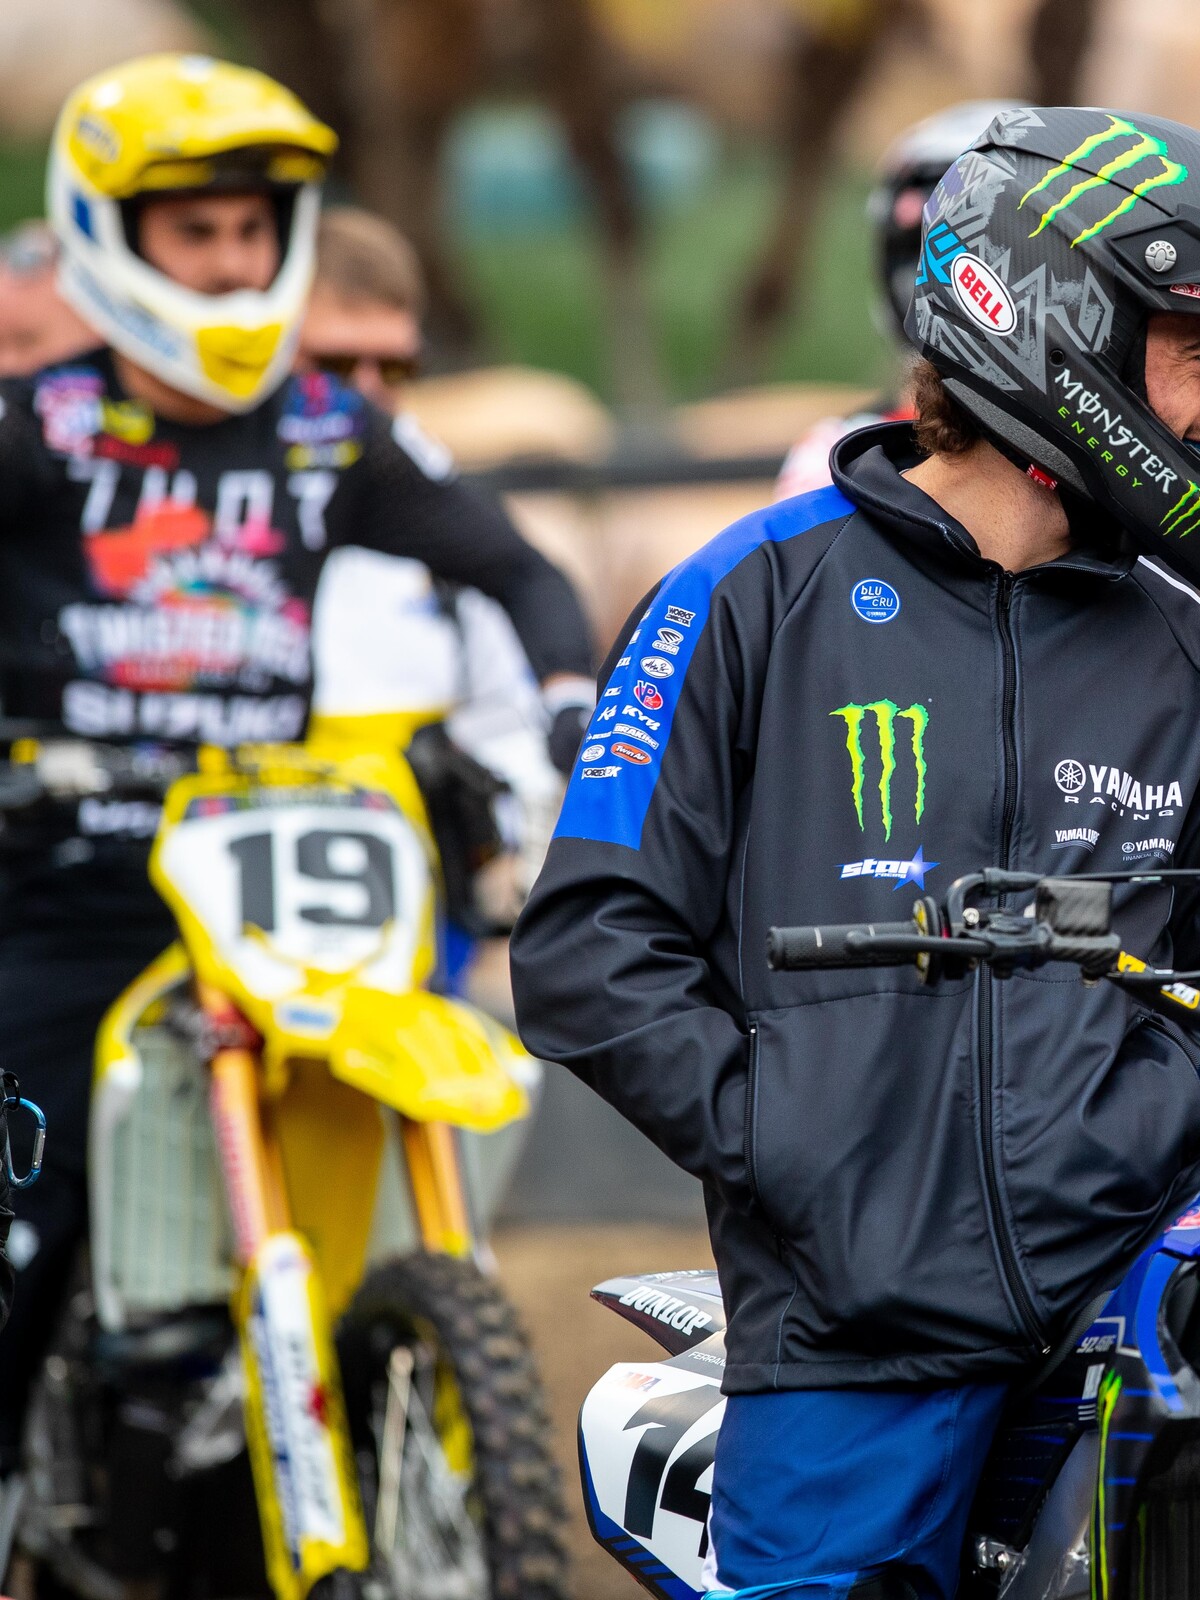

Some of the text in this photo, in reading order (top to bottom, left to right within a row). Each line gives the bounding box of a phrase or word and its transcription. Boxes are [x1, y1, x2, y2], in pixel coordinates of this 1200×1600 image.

[958, 263, 1004, 326] BELL
[1057, 405, 1143, 488] ENERGY
[613, 724, 658, 749] BRAKING
[615, 745, 635, 757] Twin
[633, 752, 646, 760] Air
[1064, 795, 1174, 820] RACING
[1088, 764, 1183, 811] YAMAHA
[228, 828, 395, 932] 19
[619, 1285, 713, 1336] DUNLOP
